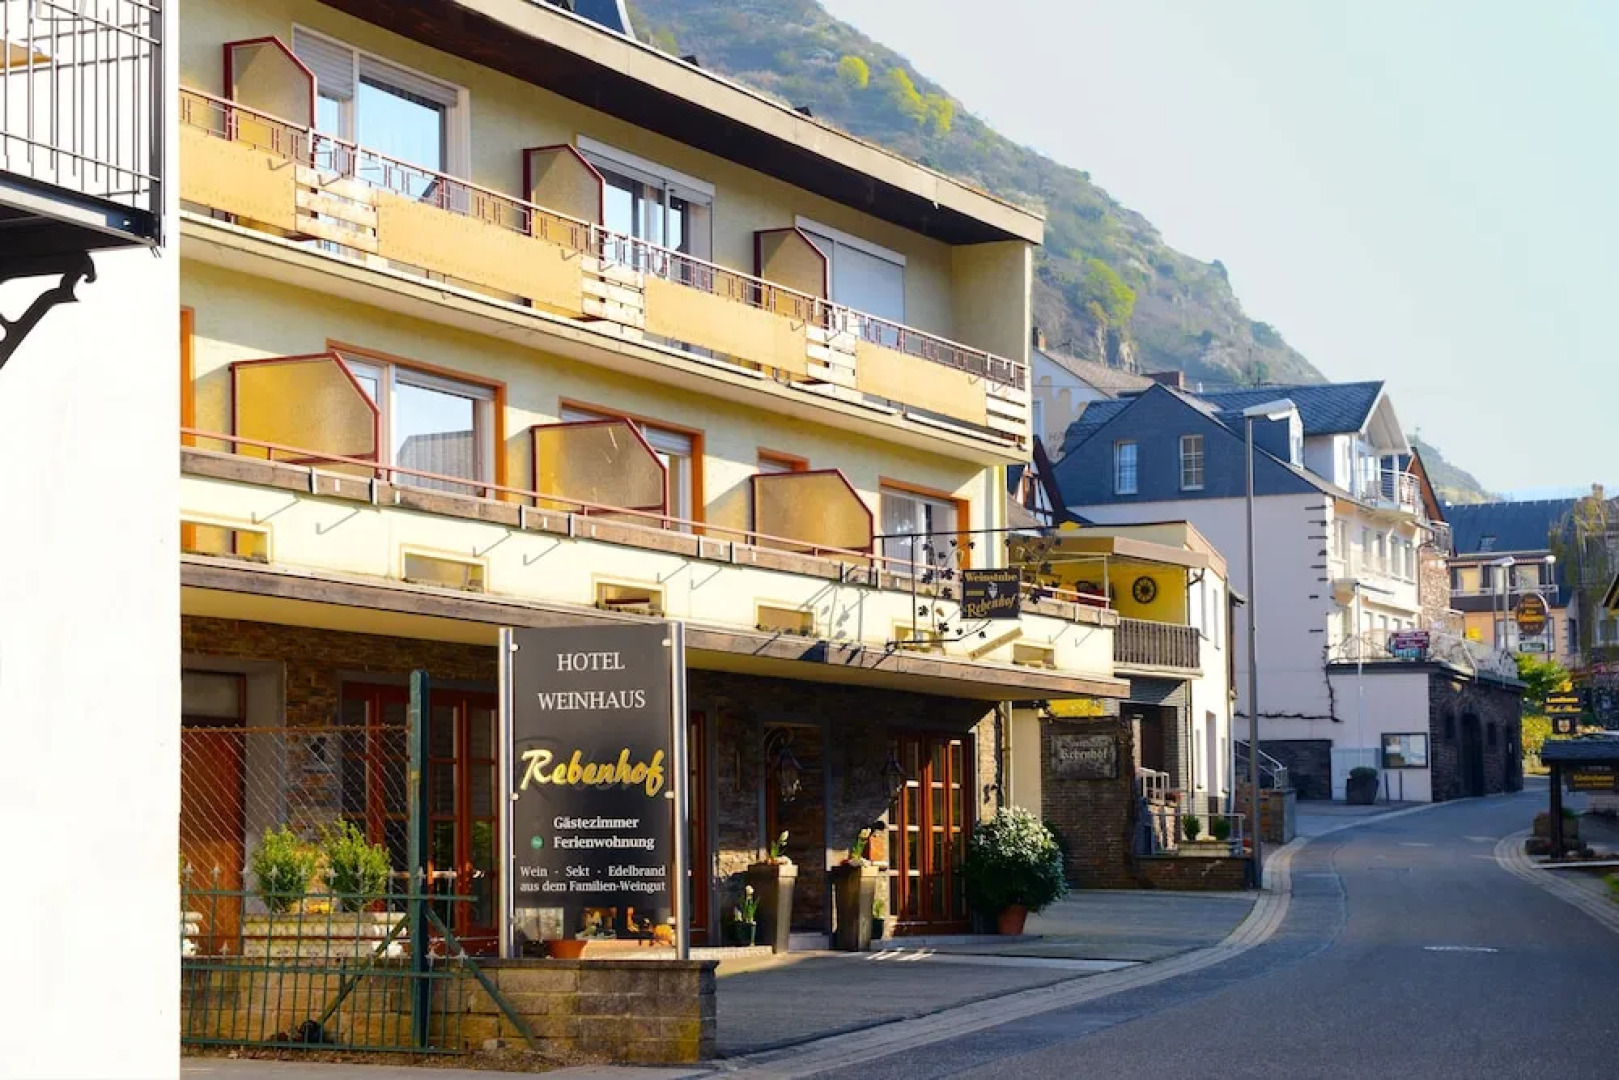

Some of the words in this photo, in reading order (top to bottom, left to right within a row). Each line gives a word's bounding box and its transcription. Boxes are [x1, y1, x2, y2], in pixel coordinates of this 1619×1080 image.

[557, 652, 626, 671] HOTEL
[538, 690, 646, 710] WEINHAUS
[520, 748, 665, 797] Rebenhof
[553, 816, 640, 829] Gästezimmer
[553, 836, 655, 850] Ferienwohnung
[519, 866, 548, 877] Wein
[565, 866, 590, 877] Sekt
[608, 865, 666, 877] Edelbrand
[519, 883, 539, 891] aus
[542, 881, 566, 891] dem
[569, 881, 666, 893] Familien-Weingut
